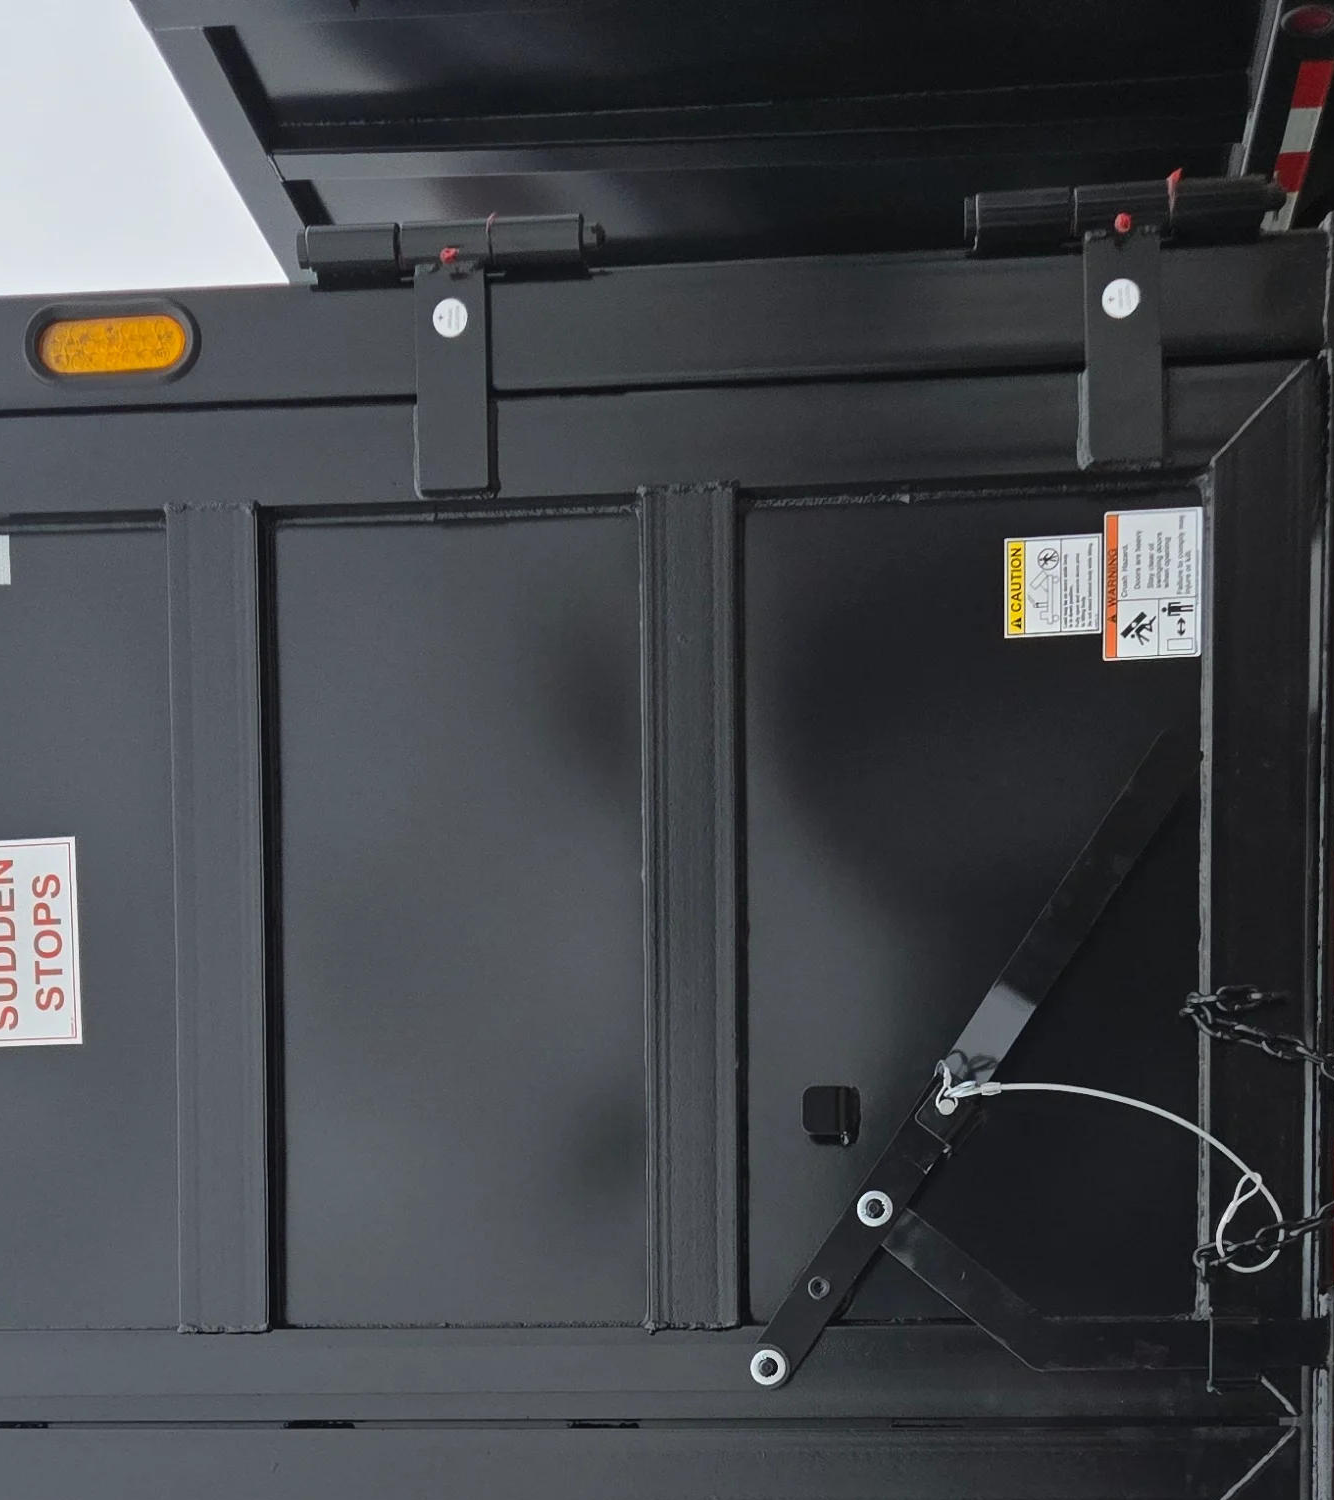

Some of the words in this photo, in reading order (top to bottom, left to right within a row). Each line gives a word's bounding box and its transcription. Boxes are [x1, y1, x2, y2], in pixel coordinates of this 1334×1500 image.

[1011, 547, 1021, 612] CAUTION
[1108, 548, 1117, 607] WARNING
[32, 874, 64, 1011] STOPS
